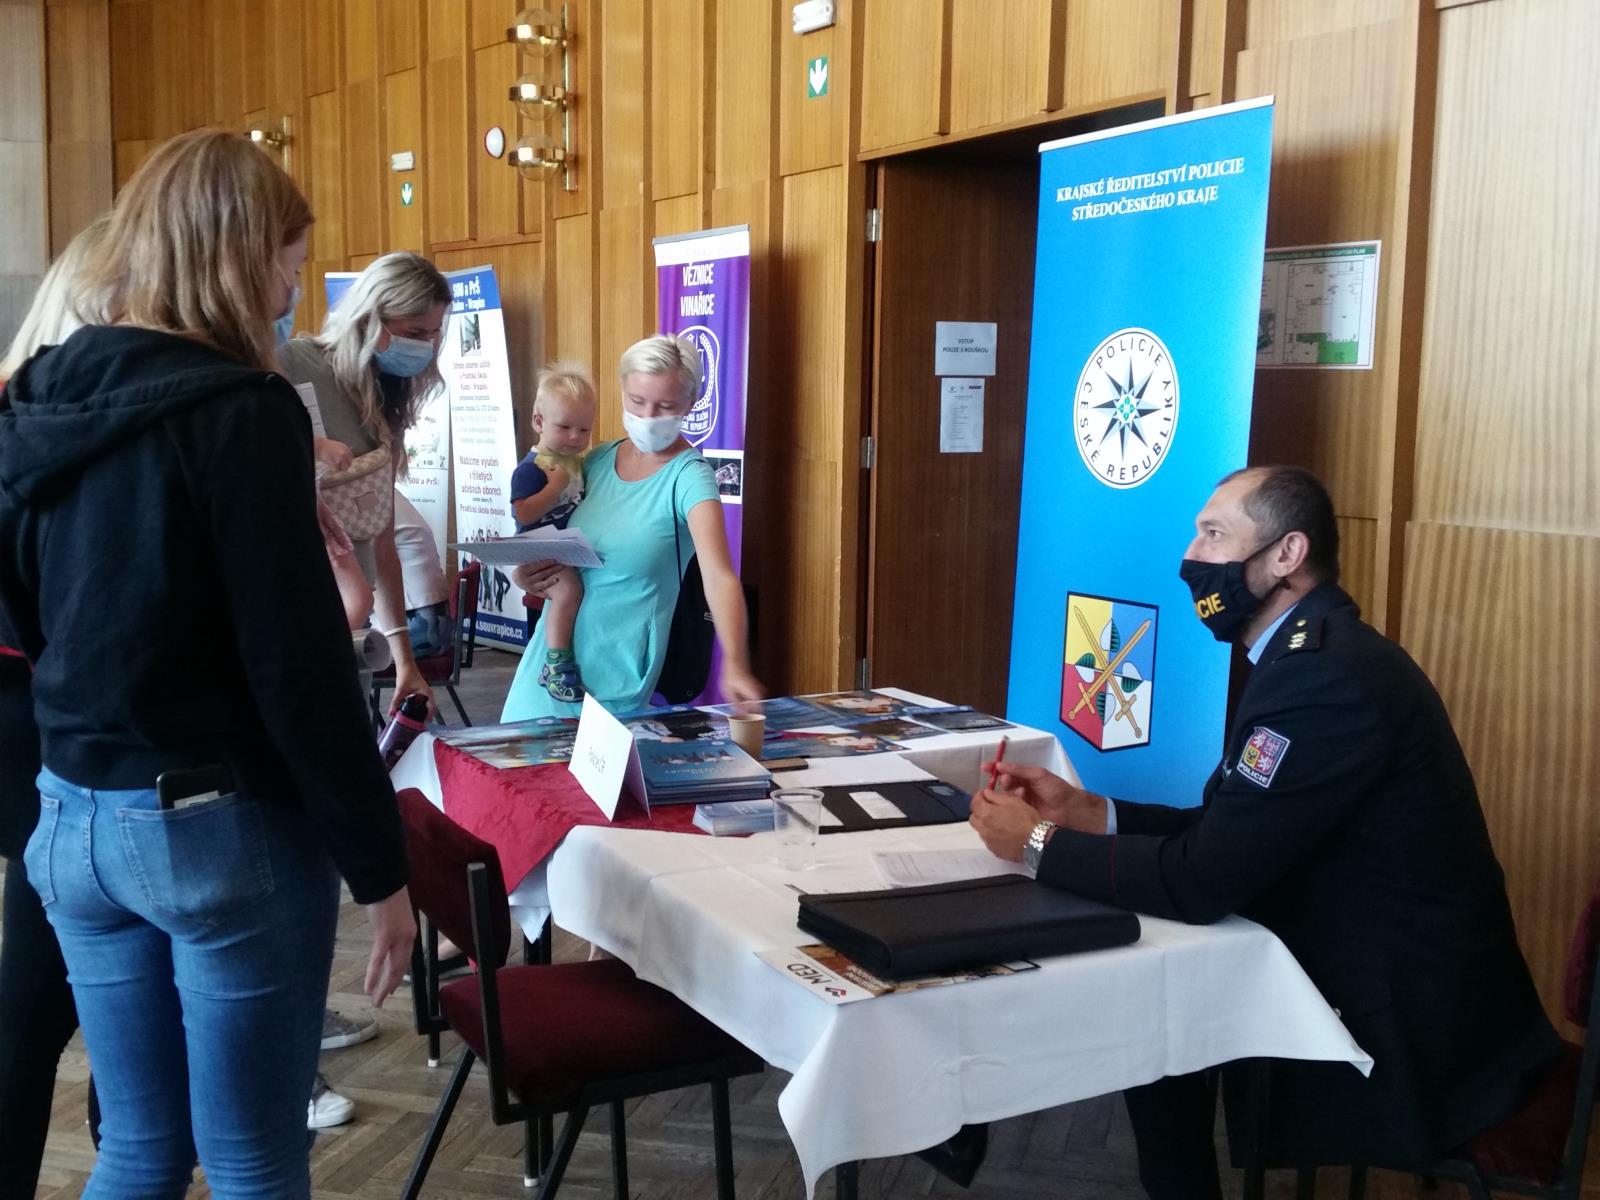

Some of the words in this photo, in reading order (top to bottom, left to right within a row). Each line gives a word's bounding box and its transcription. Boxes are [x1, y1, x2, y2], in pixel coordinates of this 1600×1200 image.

[1056, 178, 1105, 202] KRAJSKÉ
[1106, 164, 1186, 194] ŘEDITELSTVÍ
[1189, 158, 1245, 181] POLICIE
[1072, 192, 1175, 221] STŘEDOČESKÉHO
[1176, 185, 1218, 207] KRAJE
[683, 262, 714, 287] VĚZNICE
[680, 291, 715, 317] VINAŘICE
[1096, 337, 1164, 369] POLICIE
[1107, 380, 1174, 480] REPUBLIKY
[1196, 592, 1226, 619] CIE
[1239, 762, 1269, 784] POLICIE
